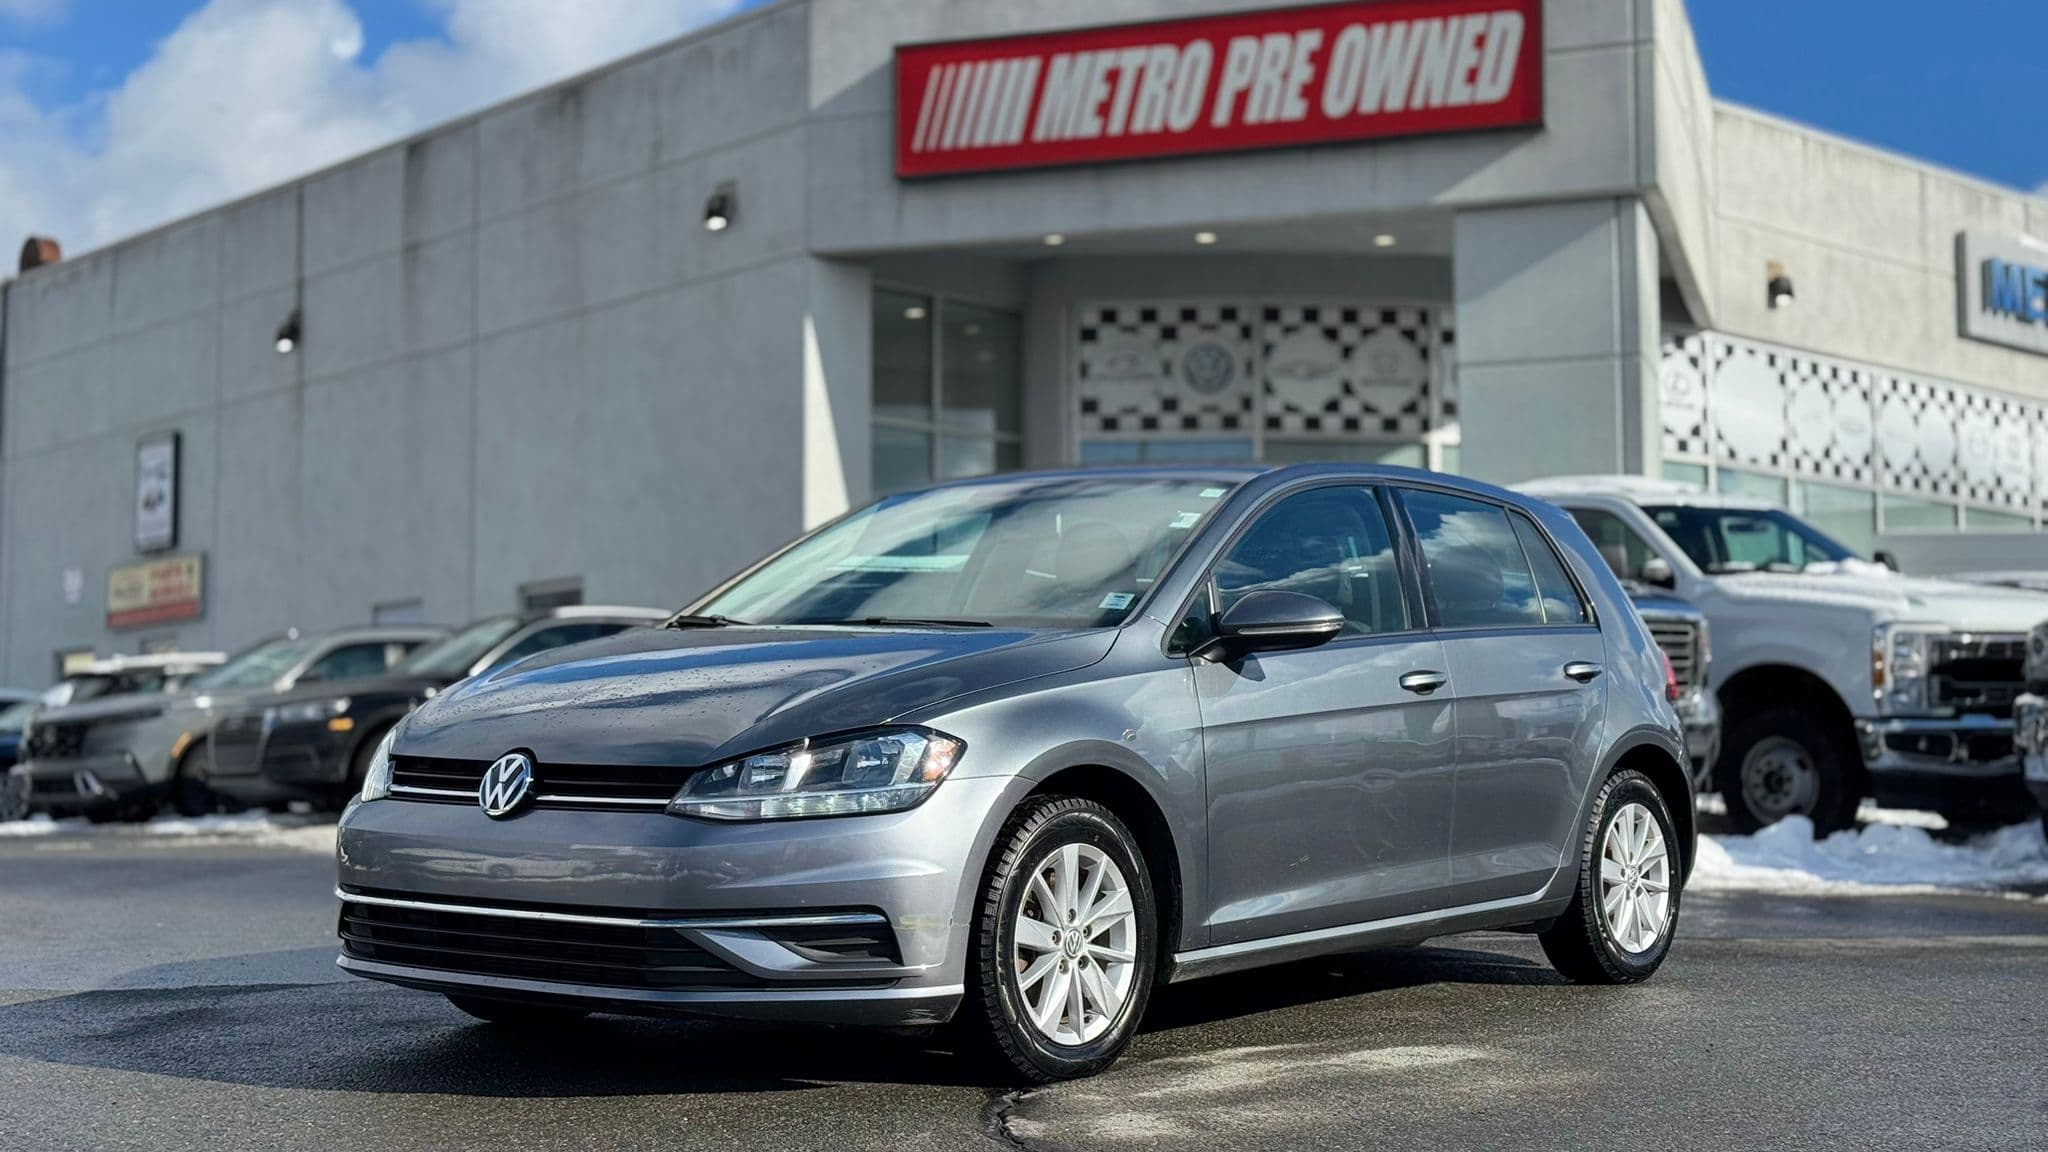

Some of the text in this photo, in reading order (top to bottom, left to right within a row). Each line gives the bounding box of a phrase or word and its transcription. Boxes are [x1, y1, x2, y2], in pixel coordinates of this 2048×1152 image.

[1032, 10, 1526, 143] METRO PRE OWNED
